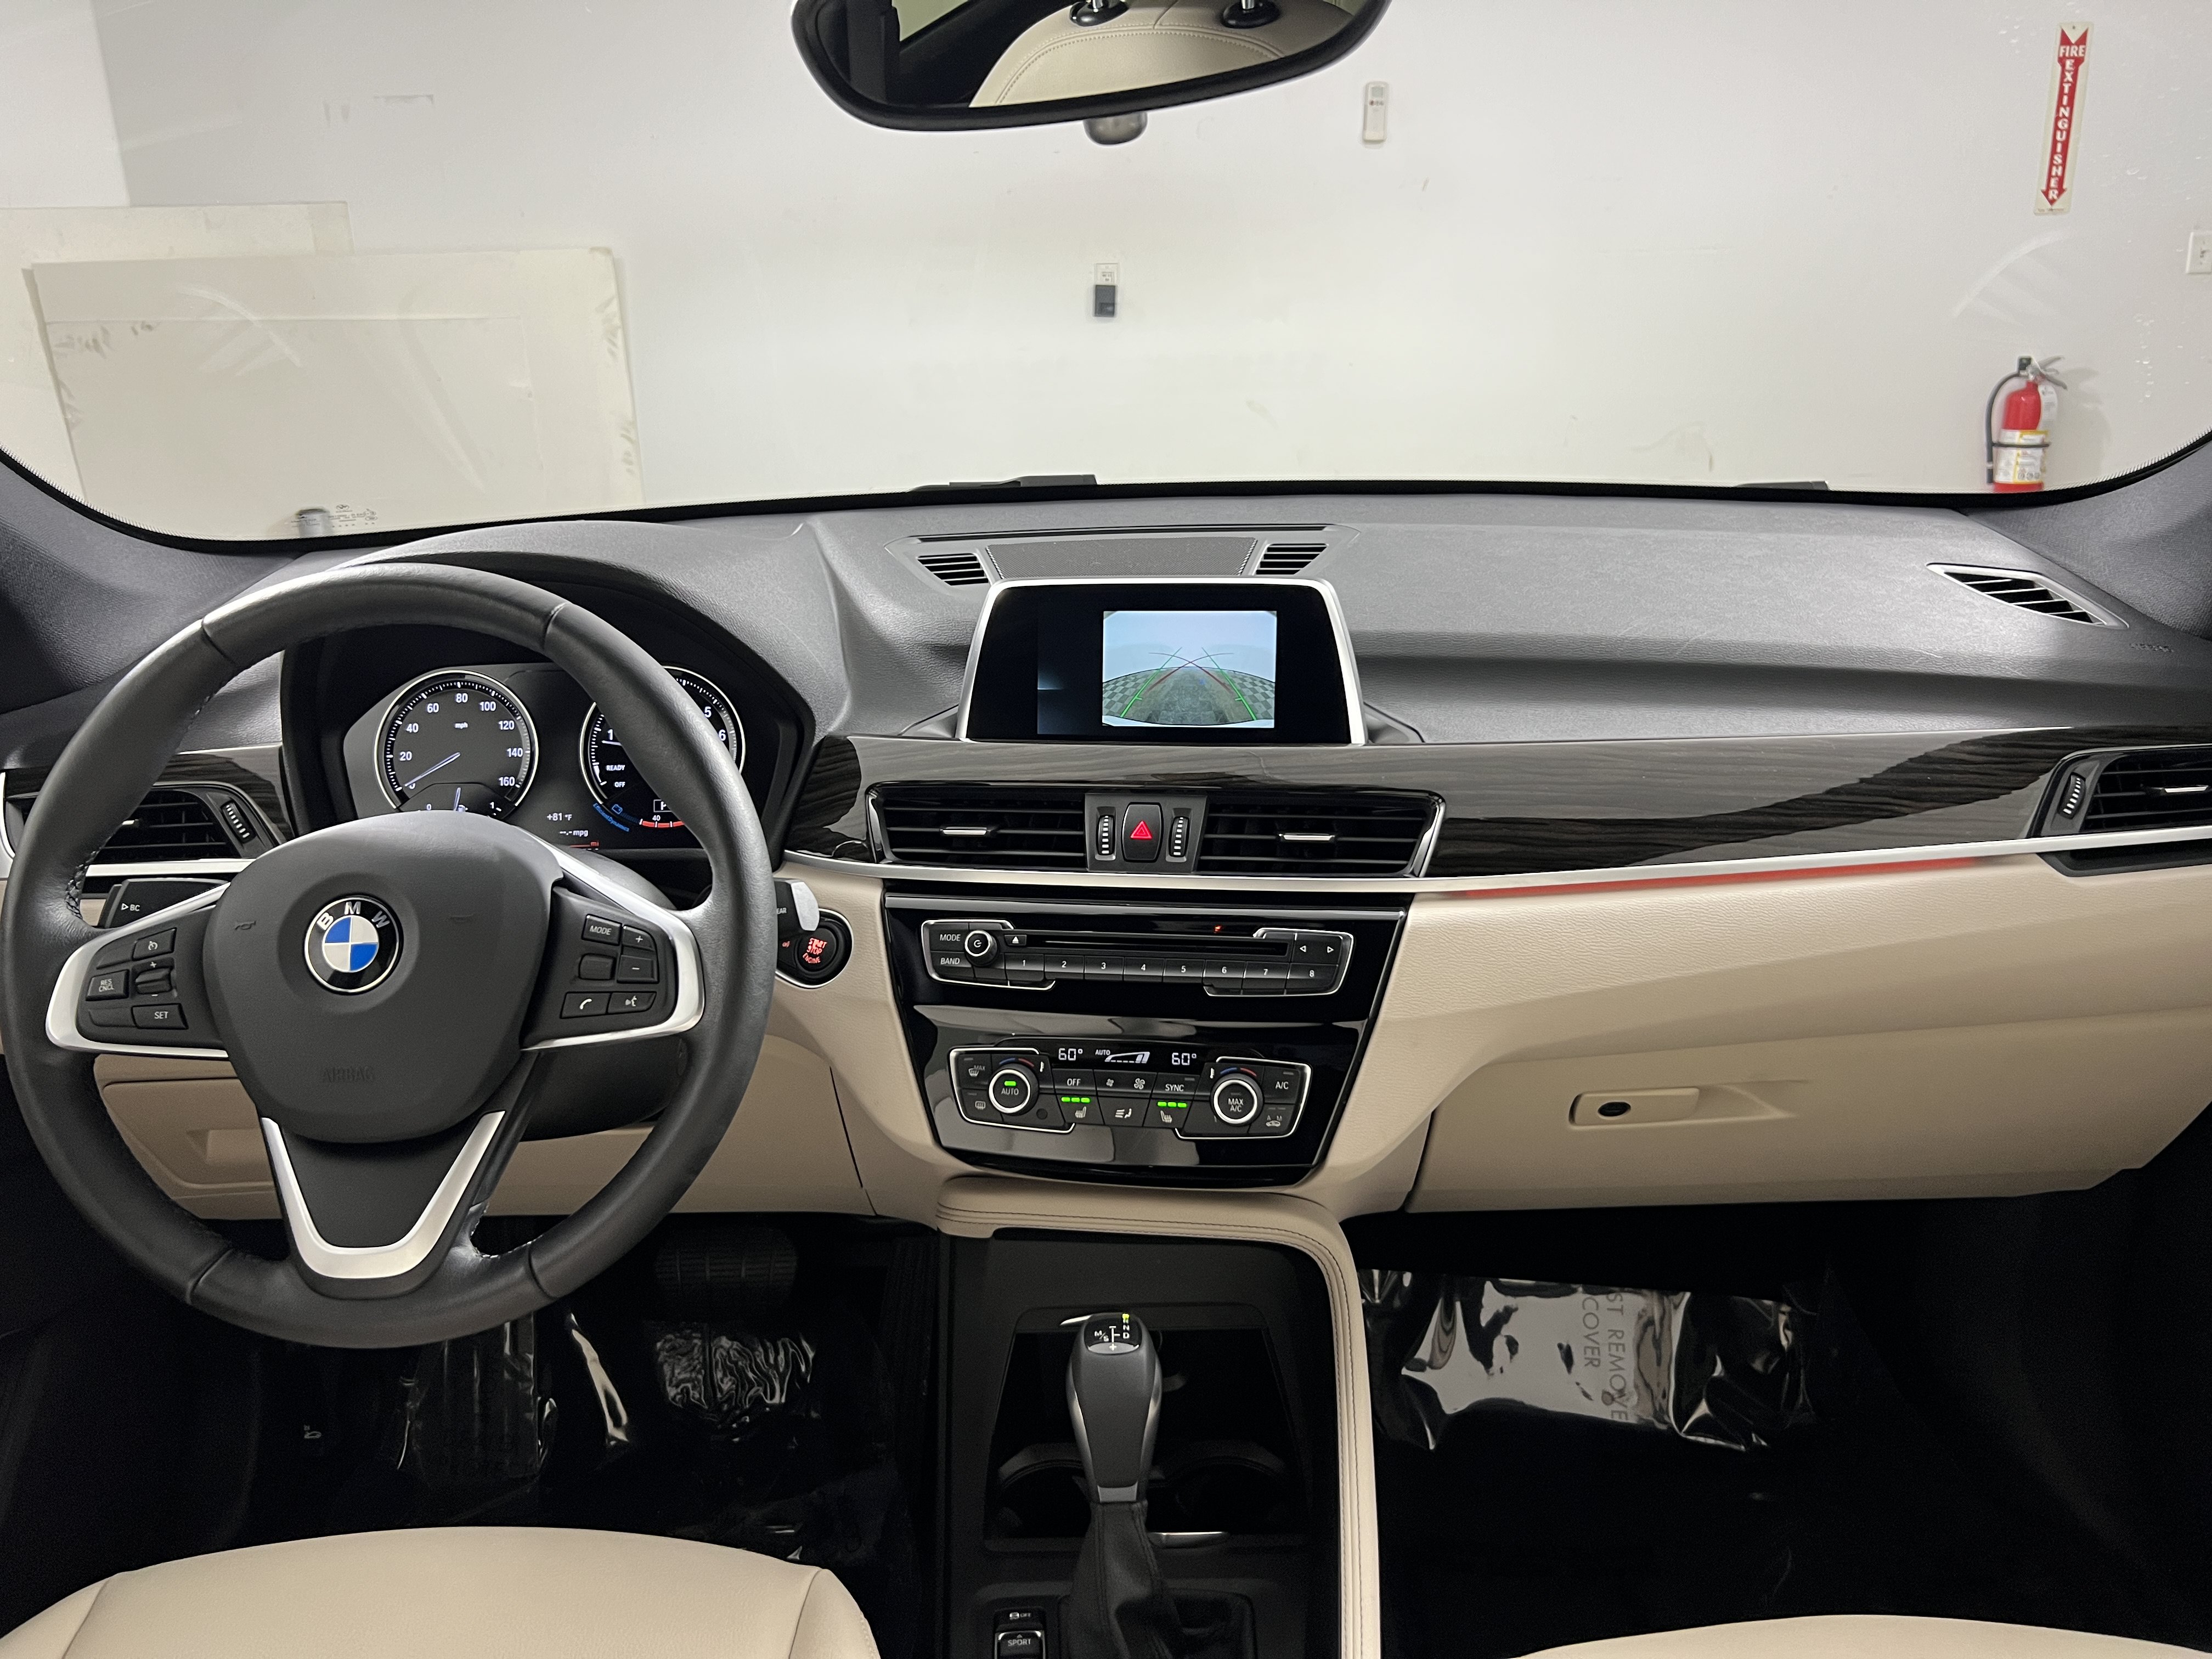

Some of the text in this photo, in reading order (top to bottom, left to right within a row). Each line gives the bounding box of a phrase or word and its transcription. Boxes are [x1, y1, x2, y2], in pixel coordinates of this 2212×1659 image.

[2059, 45, 2086, 57] FIRE
[2048, 59, 2075, 200] EXTINGUISHER
[455, 693, 468, 703] 80
[426, 703, 439, 713] 60
[479, 701, 496, 712] 100
[704, 706, 712, 718] 5
[406, 723, 419, 733] 40
[498, 720, 515, 730] 120
[607, 729, 614, 740] 1
[718, 729, 726, 741] 6
[399, 751, 412, 761] 20
[507, 748, 523, 757] 140
[499, 776, 515, 786] 160
[546, 812, 563, 821] +81
[317, 901, 390, 930] BMW
[590, 925, 612, 935] MODE
[939, 934, 961, 942] MODE
[1309, 969, 1314, 978] 8
[154, 1011, 168, 1019] SET
[1066, 1078, 1081, 1086] OFF
[1276, 1081, 1289, 1090] A/C
[1582, 1296, 1601, 1368] COVER
[1606, 1293, 1628, 1421] ST REMOVE
[1007, 1638, 1031, 1646] SPORT
